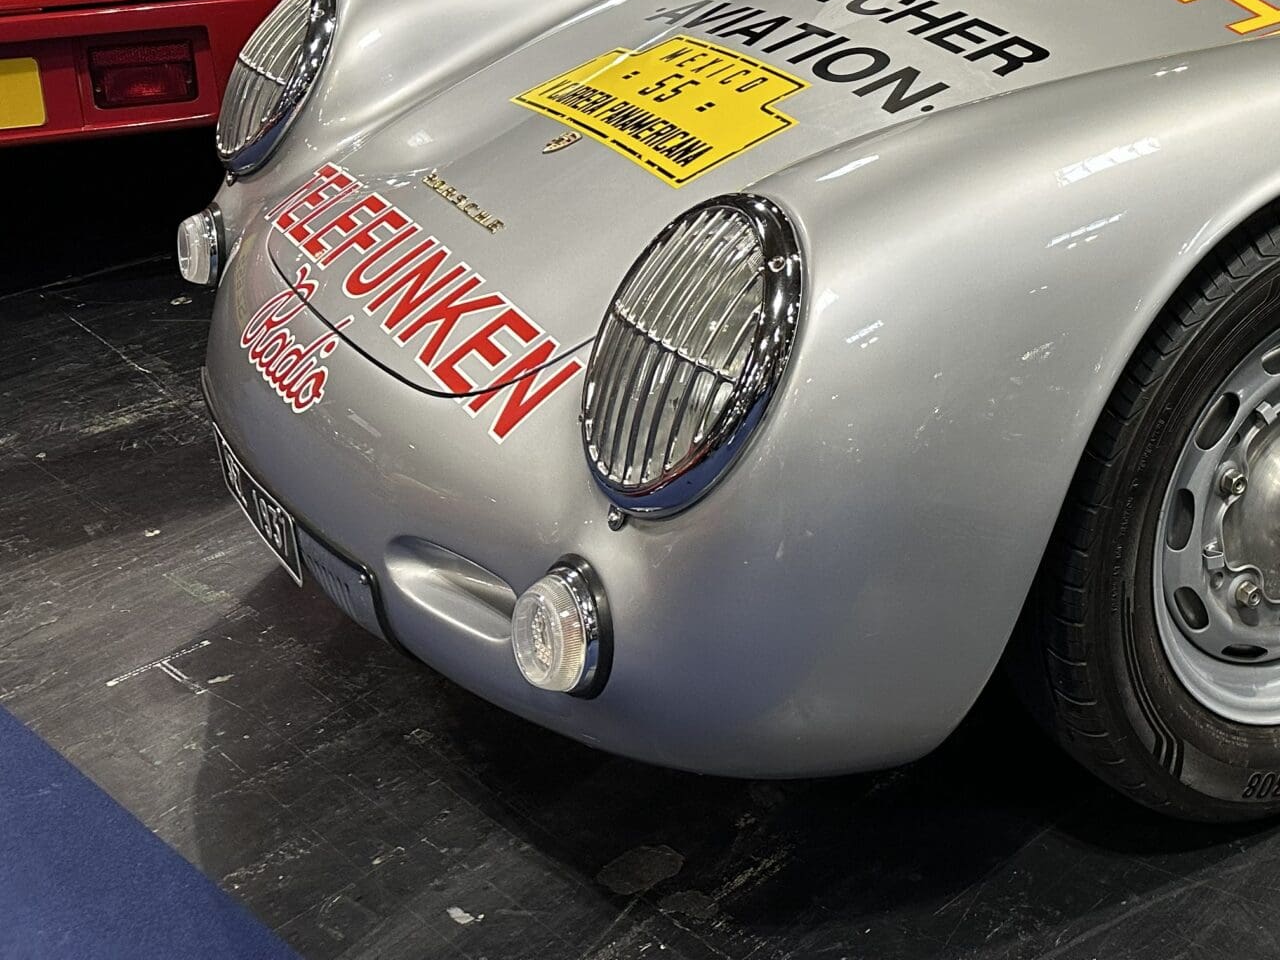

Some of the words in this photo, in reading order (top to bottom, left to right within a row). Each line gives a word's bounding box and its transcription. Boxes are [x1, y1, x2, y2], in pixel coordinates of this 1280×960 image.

[659, 46, 769, 93] MEXICO
[547, 81, 619, 116] CARRERA
[593, 98, 715, 168] PANAMERICANA
[421, 170, 507, 235] PORSCHE
[264, 161, 587, 445] TELEFUNKEN
